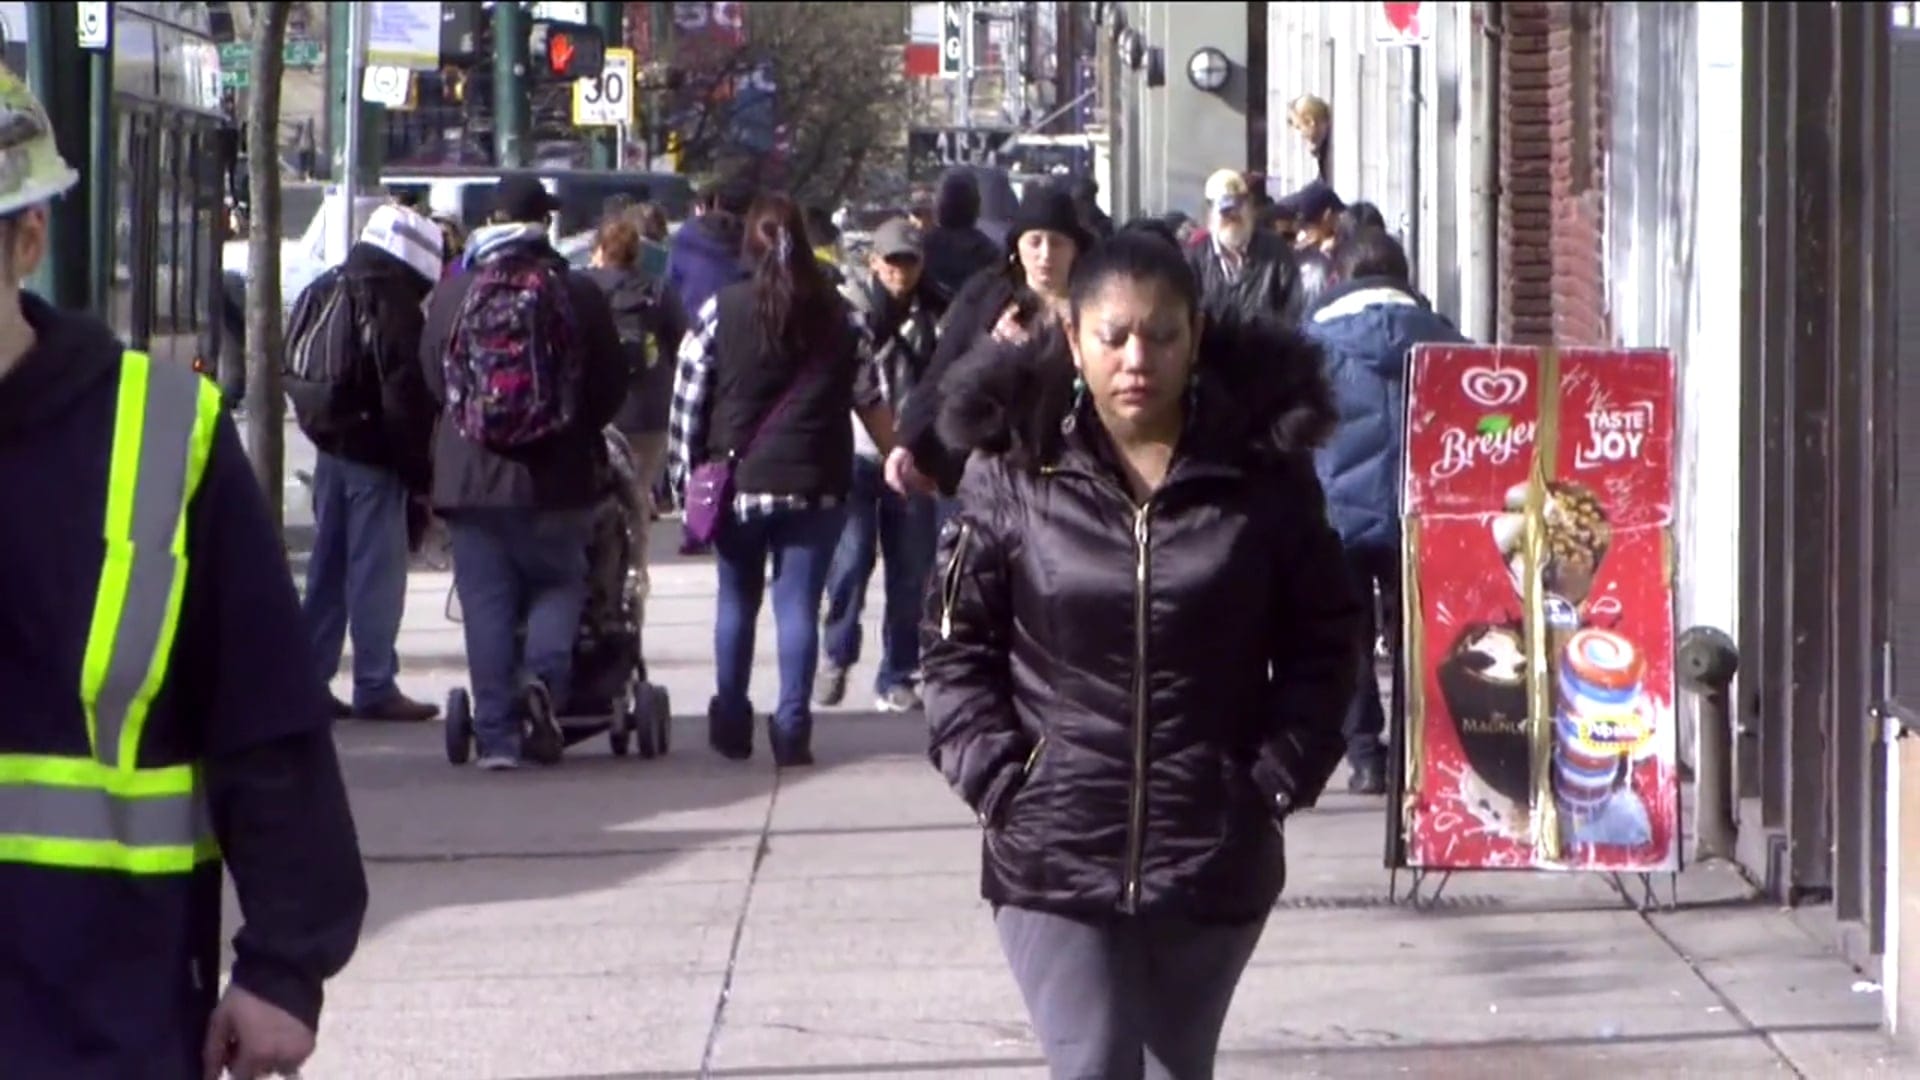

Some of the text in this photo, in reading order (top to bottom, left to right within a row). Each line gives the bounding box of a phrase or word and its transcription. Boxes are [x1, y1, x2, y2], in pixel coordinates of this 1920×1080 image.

[584, 72, 623, 104] 30
[1584, 410, 1644, 432] TASTE
[1430, 421, 1536, 478] Breyer
[1583, 430, 1644, 459] JOY
[1462, 717, 1528, 735] MAGNU
